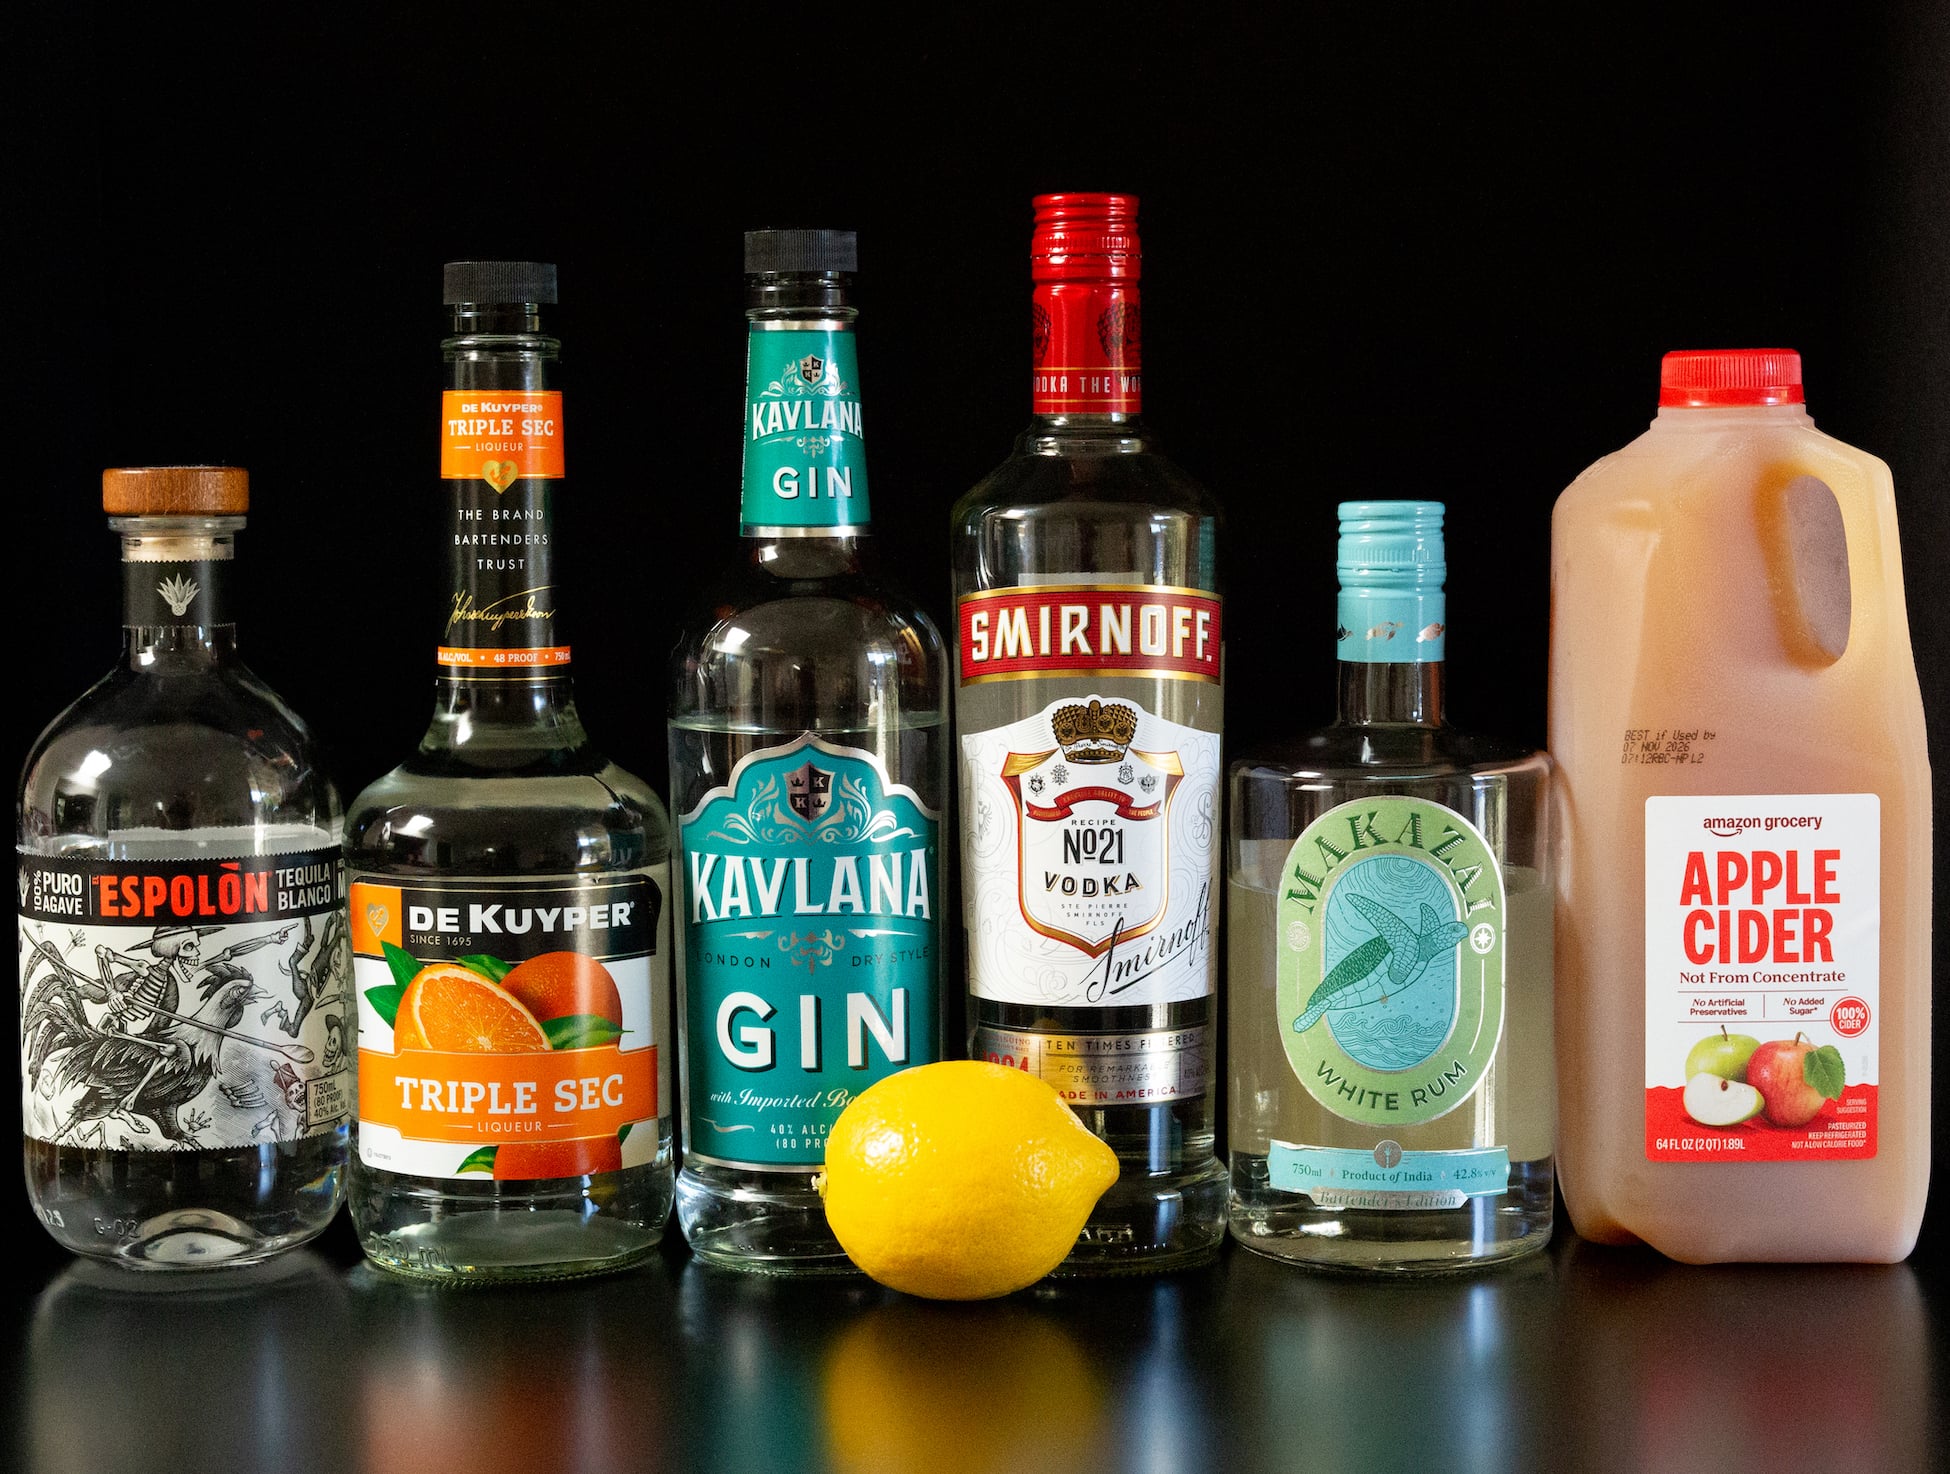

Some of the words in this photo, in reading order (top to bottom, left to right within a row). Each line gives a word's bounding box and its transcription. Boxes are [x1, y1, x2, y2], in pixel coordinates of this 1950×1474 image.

[1033, 376, 1068, 393] ODKA
[1080, 376, 1110, 393] THE
[461, 403, 478, 413] DE
[481, 402, 538, 413] KUYPER
[448, 419, 513, 436] TRIPLE
[522, 419, 554, 436] SEC
[753, 400, 863, 441] KAVLANA
[475, 442, 524, 452] LIQUEUR
[772, 466, 854, 499] GIN
[458, 509, 483, 521] THE
[492, 509, 544, 520] BRAND
[454, 534, 549, 545] BARTENDERS
[477, 559, 525, 570] TRUST
[494, 653, 505, 663] 48
[508, 653, 538, 663] PROOF
[1624, 729, 1650, 741] BEST
[1656, 730, 1667, 741] if
[1673, 729, 1698, 741] Used
[1703, 729, 1716, 741] by
[1623, 742, 1636, 753] 07
[1641, 742, 1660, 752] NOV
[1665, 742, 1690, 753] 2026
[1703, 817, 1761, 829] amazon
[1765, 816, 1823, 831] grocery
[1286, 811, 1496, 920] MAKAZAI
[275, 863, 331, 888] TEQUILA
[1679, 849, 1841, 905] APPLE
[33, 870, 42, 911] 100%
[42, 872, 82, 896] PURO
[100, 862, 269, 918] ESPOLÓN
[690, 848, 931, 925] KAVLANA
[1044, 871, 1143, 898] VODKA
[277, 885, 331, 911] BLANCO
[42, 896, 83, 915] AGAVE
[409, 905, 459, 932] DE
[469, 902, 632, 934] KUYPER
[409, 934, 441, 945] SINCE
[446, 936, 473, 947] 1695
[1683, 908, 1835, 965] CIDER
[696, 951, 771, 969] LONDON
[852, 952, 883, 967] DRY
[890, 946, 929, 964] STYLE
[1679, 972, 1704, 984] Not
[1709, 972, 1749, 984] From
[1753, 970, 1846, 984] Concentrate
[1692, 999, 1706, 1007] No
[1708, 998, 1745, 1007] Artificial
[1783, 998, 1797, 1006] No
[1798, 997, 1825, 1006] Added
[1690, 1008, 1748, 1017] Preservatives
[1836, 1006, 1866, 1020] 100%
[716, 987, 910, 1073] GIN
[1838, 1019, 1861, 1030] CIDER
[1047, 1039, 1076, 1050] TEN
[1086, 1039, 1131, 1051] TIMES
[1140, 1033, 1195, 1049] FIERED
[1059, 1065, 1083, 1073] FOR
[1073, 1073, 1157, 1083] SMOOTHNES
[1317, 1059, 1399, 1111] WHITE
[1411, 1059, 1468, 1107] RUM
[395, 1076, 537, 1115] TRIPLE
[554, 1074, 624, 1113] SEC
[1058, 1090, 1087, 1100] ADE
[1094, 1091, 1108, 1100] IN
[1116, 1086, 1176, 1099] AMERICA
[710, 1091, 732, 1104] with
[734, 1088, 822, 1113] Imported
[477, 1121, 543, 1133] LIQUEUR
[770, 1124, 794, 1135] 40%
[1827, 1121, 1867, 1130] PASTEURIZED
[1808, 1131, 1823, 1140] KEEP
[1824, 1130, 1867, 1139] REFRIGERATED
[776, 1138, 797, 1150] (80
[1656, 1139, 1669, 1150] 64
[1670, 1139, 1681, 1150] FL
[1682, 1139, 1693, 1150] OZ
[1695, 1138, 1705, 1151] (2
[1705, 1138, 1721, 1151] QT)
[1722, 1137, 1746, 1150] 1.89L
[1791, 1141, 1803, 1149] NOT
[1823, 1140, 1847, 1148] CALORIE
[1293, 1163, 1322, 1177] 750ml
[1342, 1169, 1386, 1181] Product
[1389, 1171, 1401, 1184] of
[1404, 1171, 1432, 1182] India
